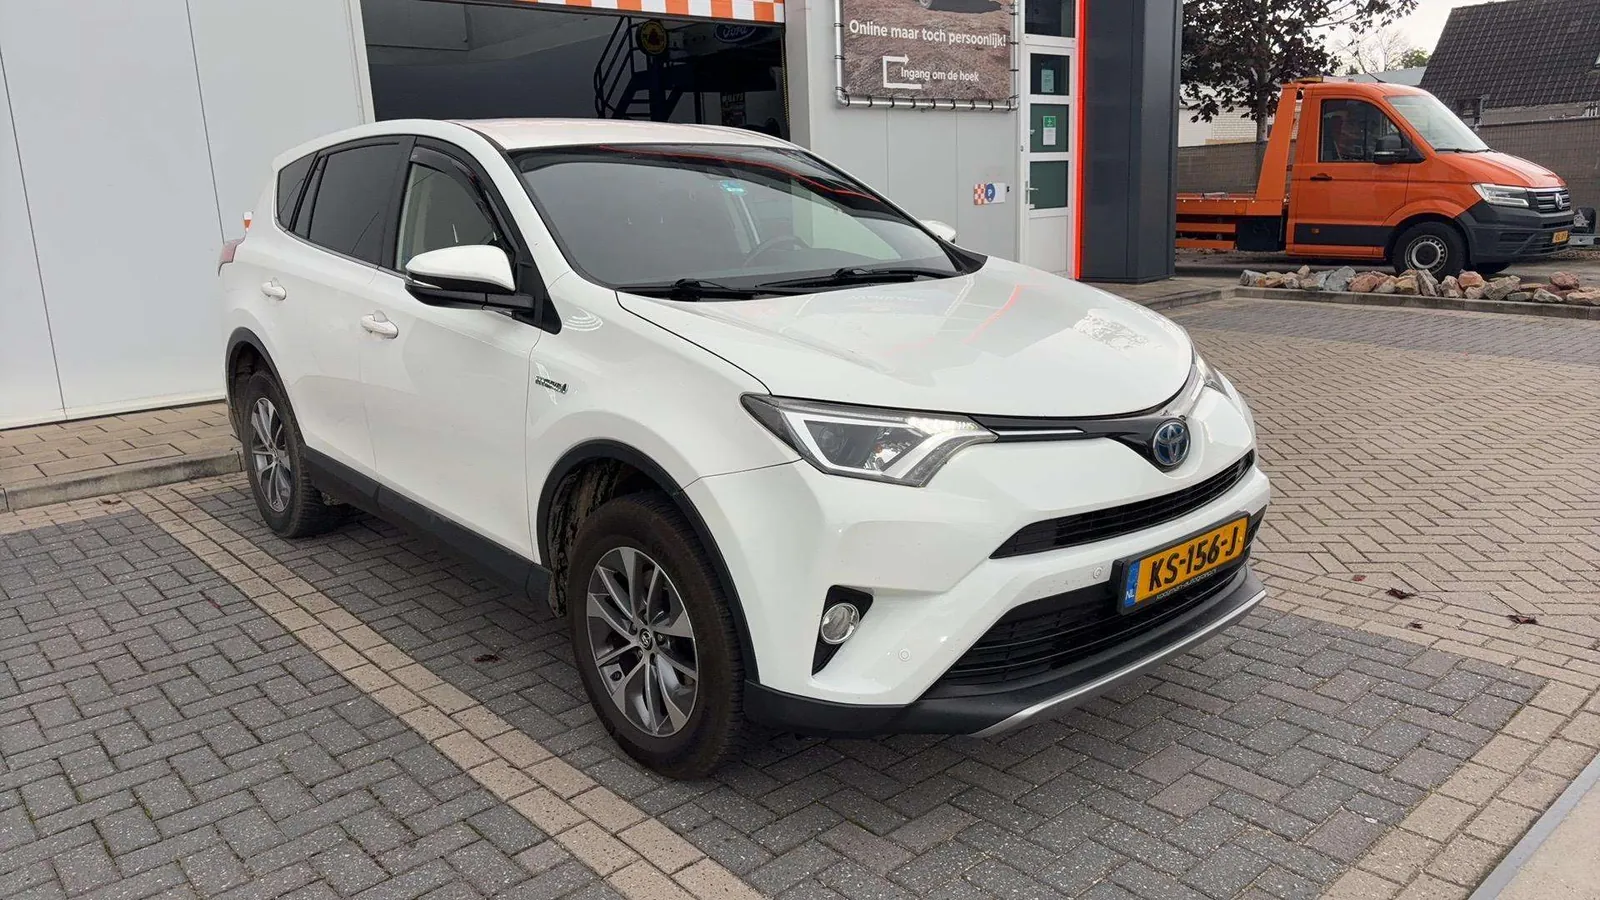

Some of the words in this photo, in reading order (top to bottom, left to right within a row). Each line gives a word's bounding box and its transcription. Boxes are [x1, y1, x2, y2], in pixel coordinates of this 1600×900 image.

[849, 19, 888, 37] Online
[891, 25, 918, 40] maar
[922, 28, 946, 42] toch
[949, 32, 1007, 48] persoonlijk!
[900, 67, 930, 81] Ingang
[932, 71, 946, 80] om
[947, 70, 958, 81] de
[959, 71, 980, 82] hoek
[1149, 526, 1239, 591] KS-156-J
[1125, 588, 1135, 600] NL
